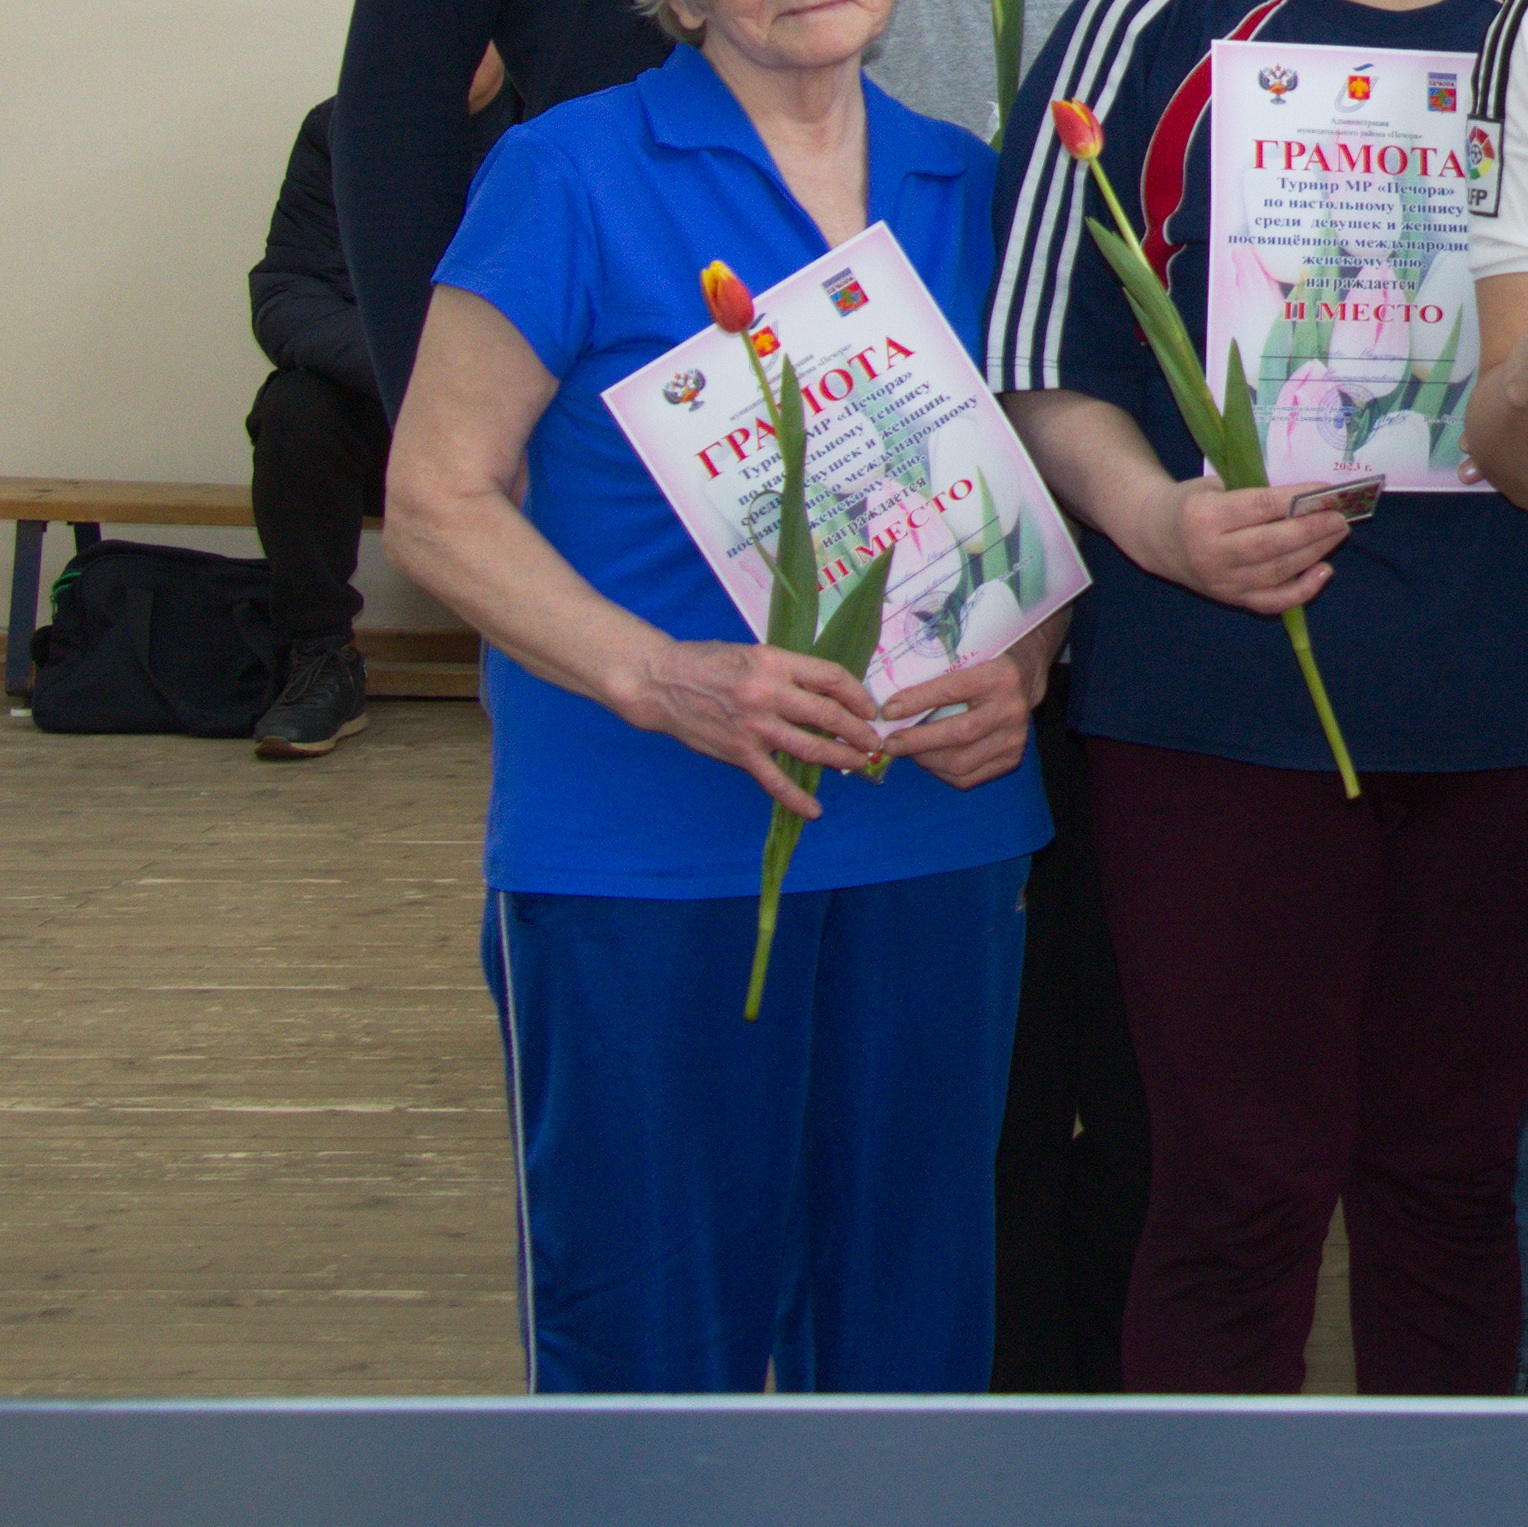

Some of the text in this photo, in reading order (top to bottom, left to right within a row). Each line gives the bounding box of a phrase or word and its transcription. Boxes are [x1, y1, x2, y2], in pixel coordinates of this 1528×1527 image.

[1252, 139, 1467, 179] ГРАМОТА
[1277, 177, 1455, 198] Турнир МР «Печора»
[1263, 197, 1464, 218] по настольному теннису
[1254, 216, 1301, 228] среди
[1310, 217, 1381, 232] девушек
[1386, 221, 1396, 231] и
[1227, 234, 1469, 253] посвящённого международн
[1302, 254, 1426, 270] женскому дню.
[1306, 276, 1414, 291] награждается
[1320, 300, 1443, 325] МЕСТО
[738, 451, 782, 482] Турн
[836, 370, 913, 422] «Печора»
[842, 393, 984, 485] международному
[737, 489, 758, 506] по
[866, 380, 935, 426] теннису
[801, 445, 863, 491] евушек
[863, 437, 877, 451] и
[877, 396, 953, 443] женщин,
[883, 456, 927, 484] дню.
[1332, 462, 1361, 471] 2023
[820, 476, 928, 549] награждается
[852, 479, 976, 564] МЕСТО
